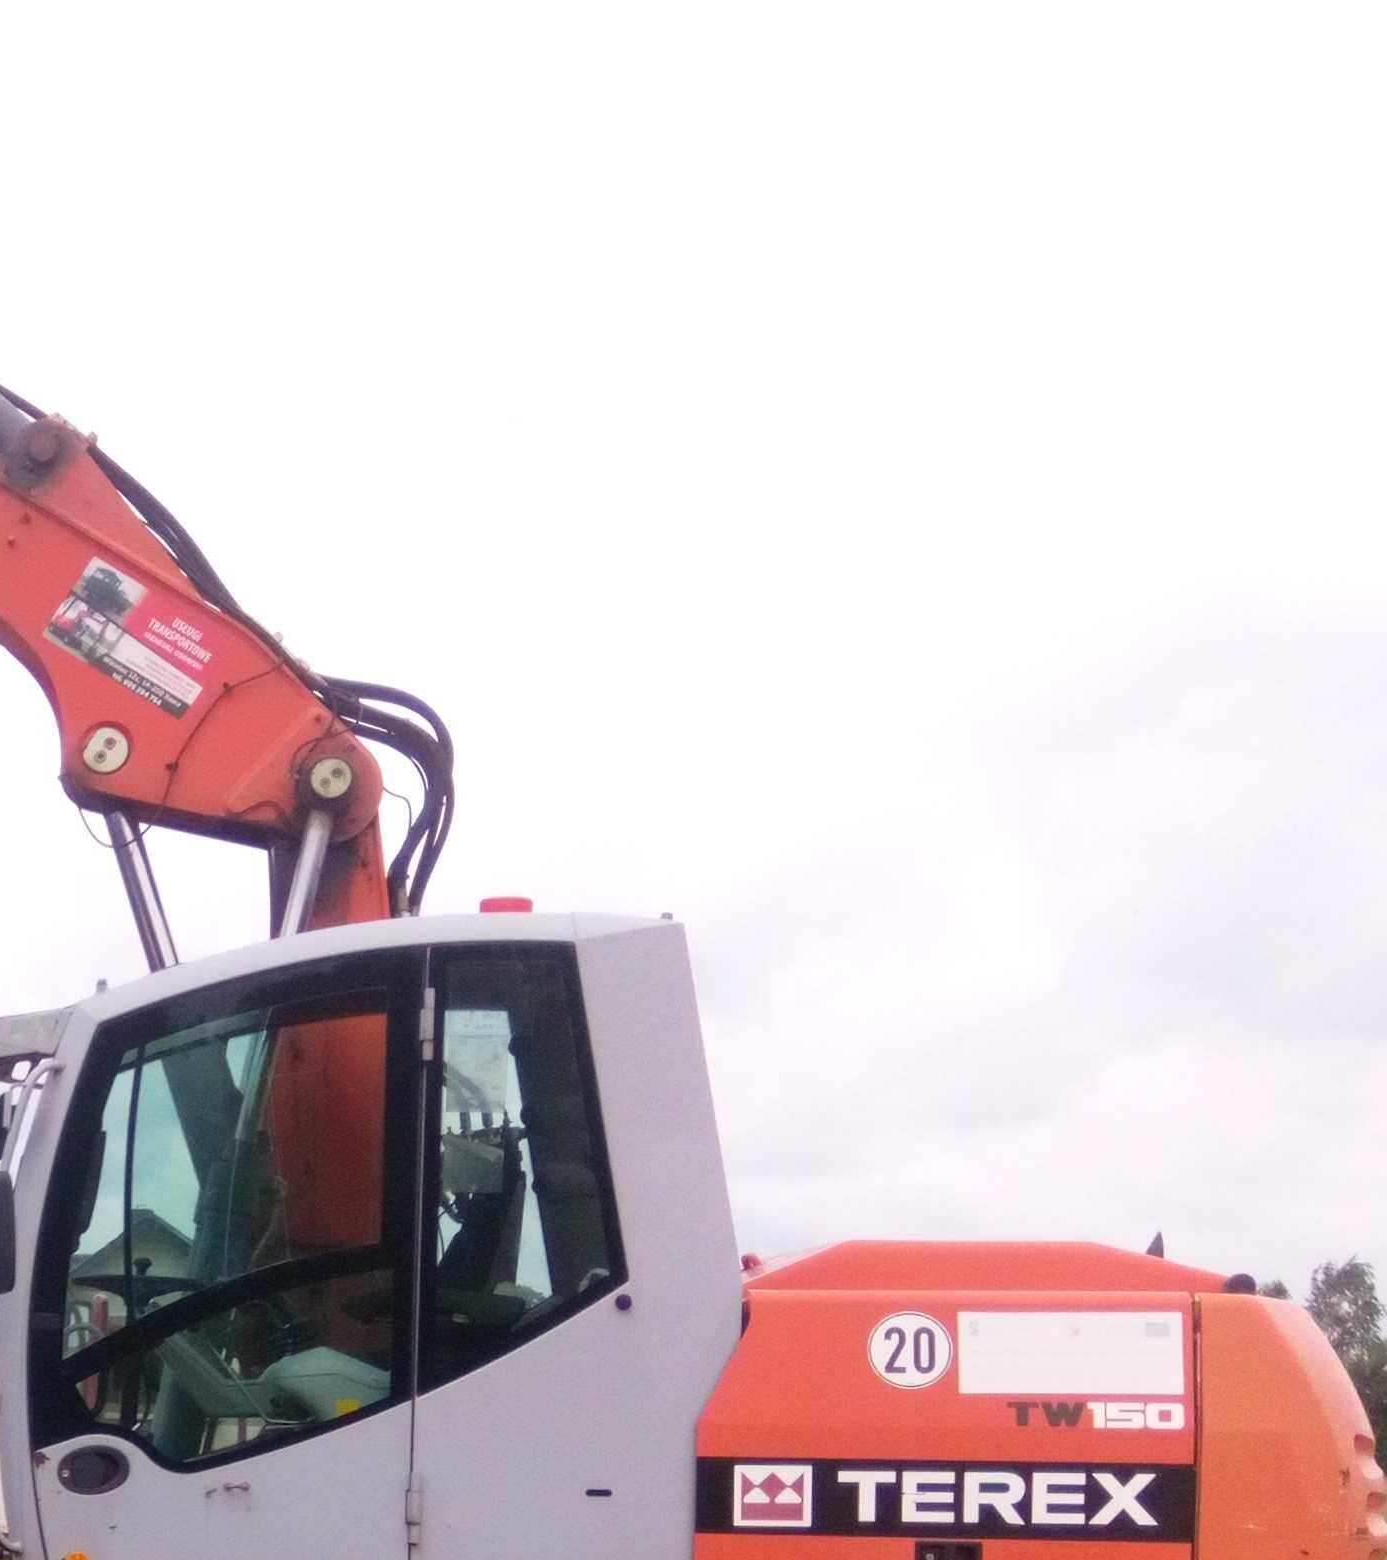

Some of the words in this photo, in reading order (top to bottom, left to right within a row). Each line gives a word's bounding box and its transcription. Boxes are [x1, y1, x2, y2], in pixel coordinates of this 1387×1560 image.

[148, 618, 213, 664] TRANSPORTOWE
[883, 1326, 936, 1374] 20
[837, 1470, 1159, 1526] TEREX
